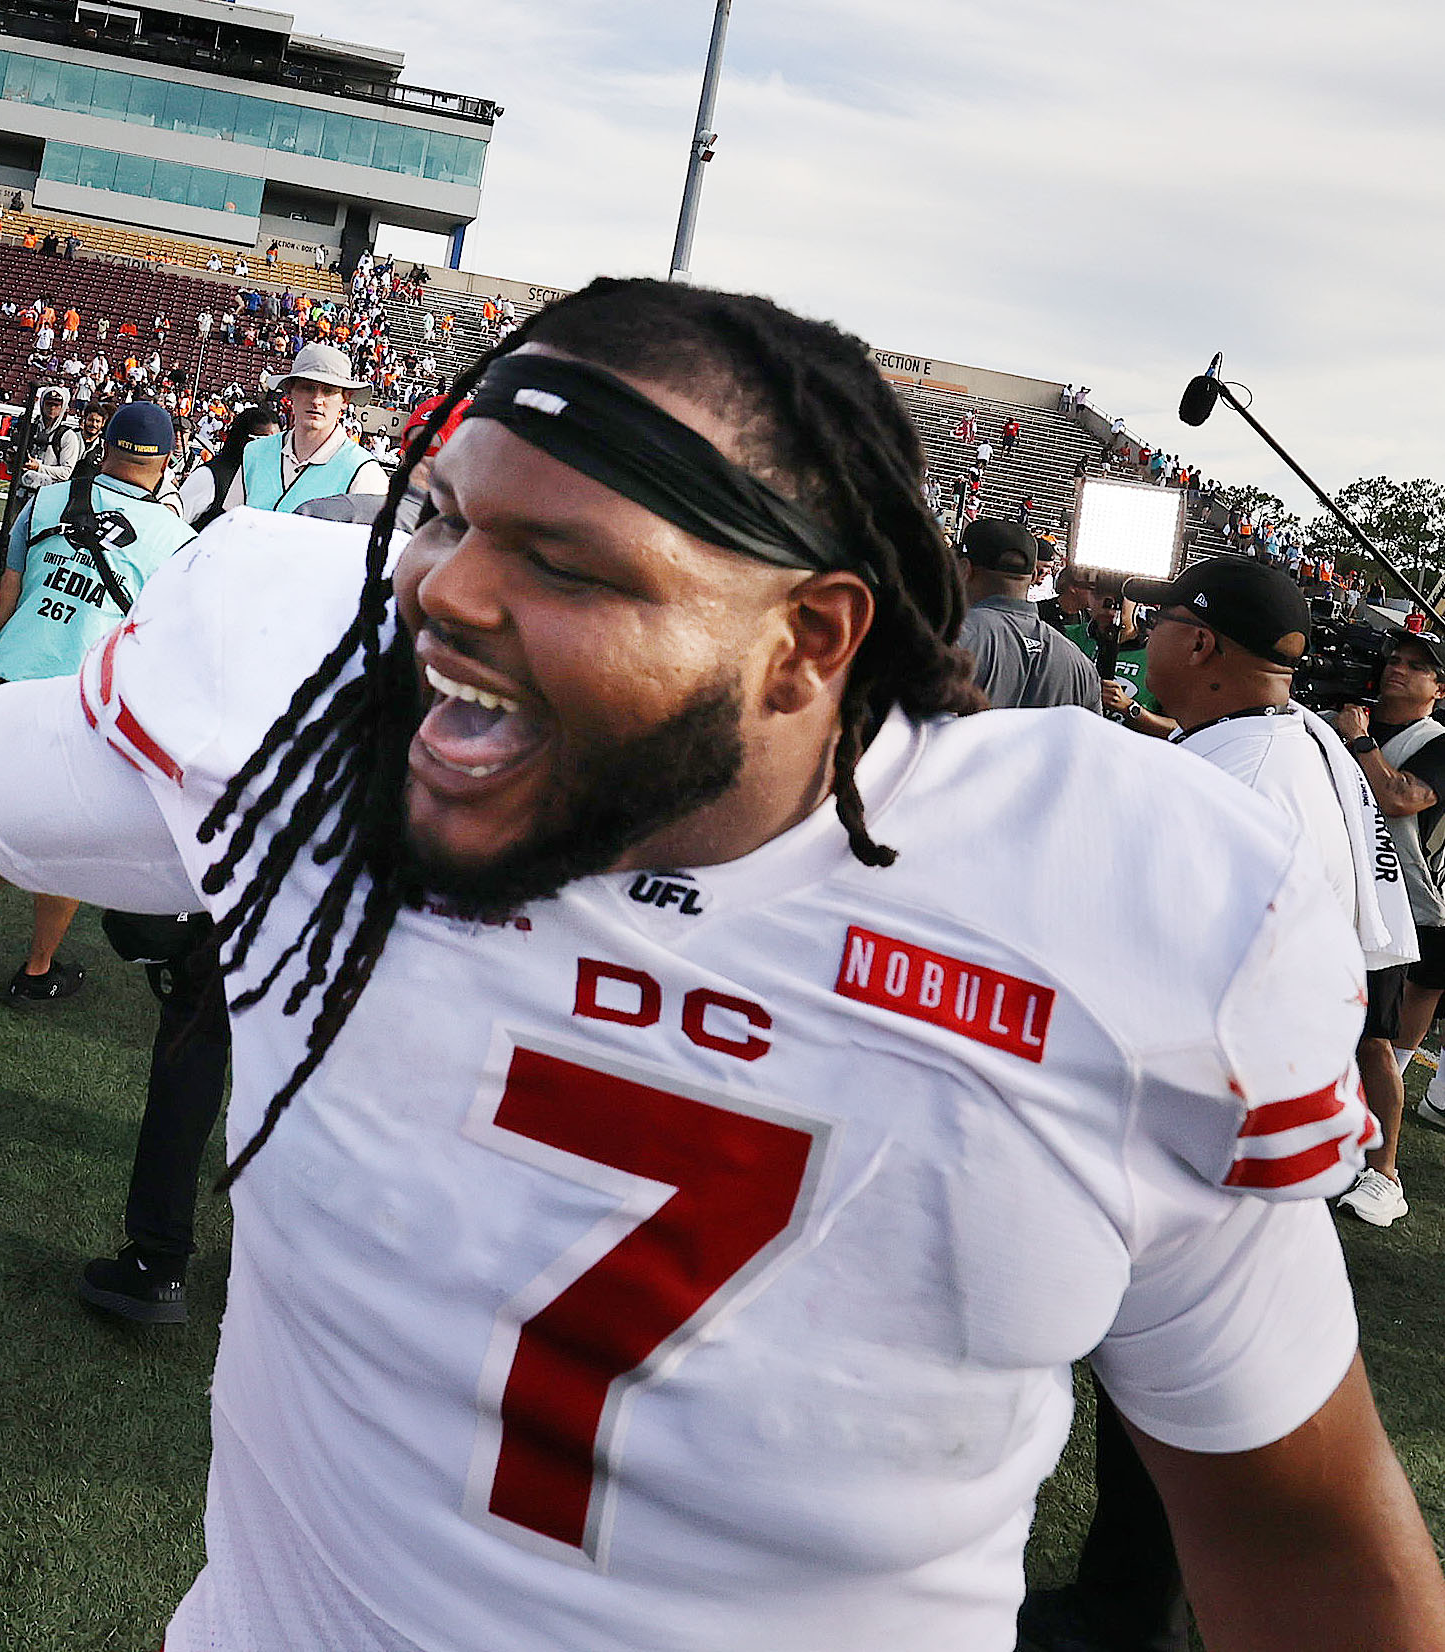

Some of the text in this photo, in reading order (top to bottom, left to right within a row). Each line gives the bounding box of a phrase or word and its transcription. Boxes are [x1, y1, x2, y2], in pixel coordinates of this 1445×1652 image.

[875, 352, 932, 376] SECTION E
[360, 411, 369, 422] C
[391, 416, 400, 427] D
[37, 597, 77, 625] 267
[628, 874, 703, 915] UFL
[844, 935, 1043, 1046] NOBULL
[573, 956, 772, 1062] DC
[479, 1034, 826, 1560] 7
